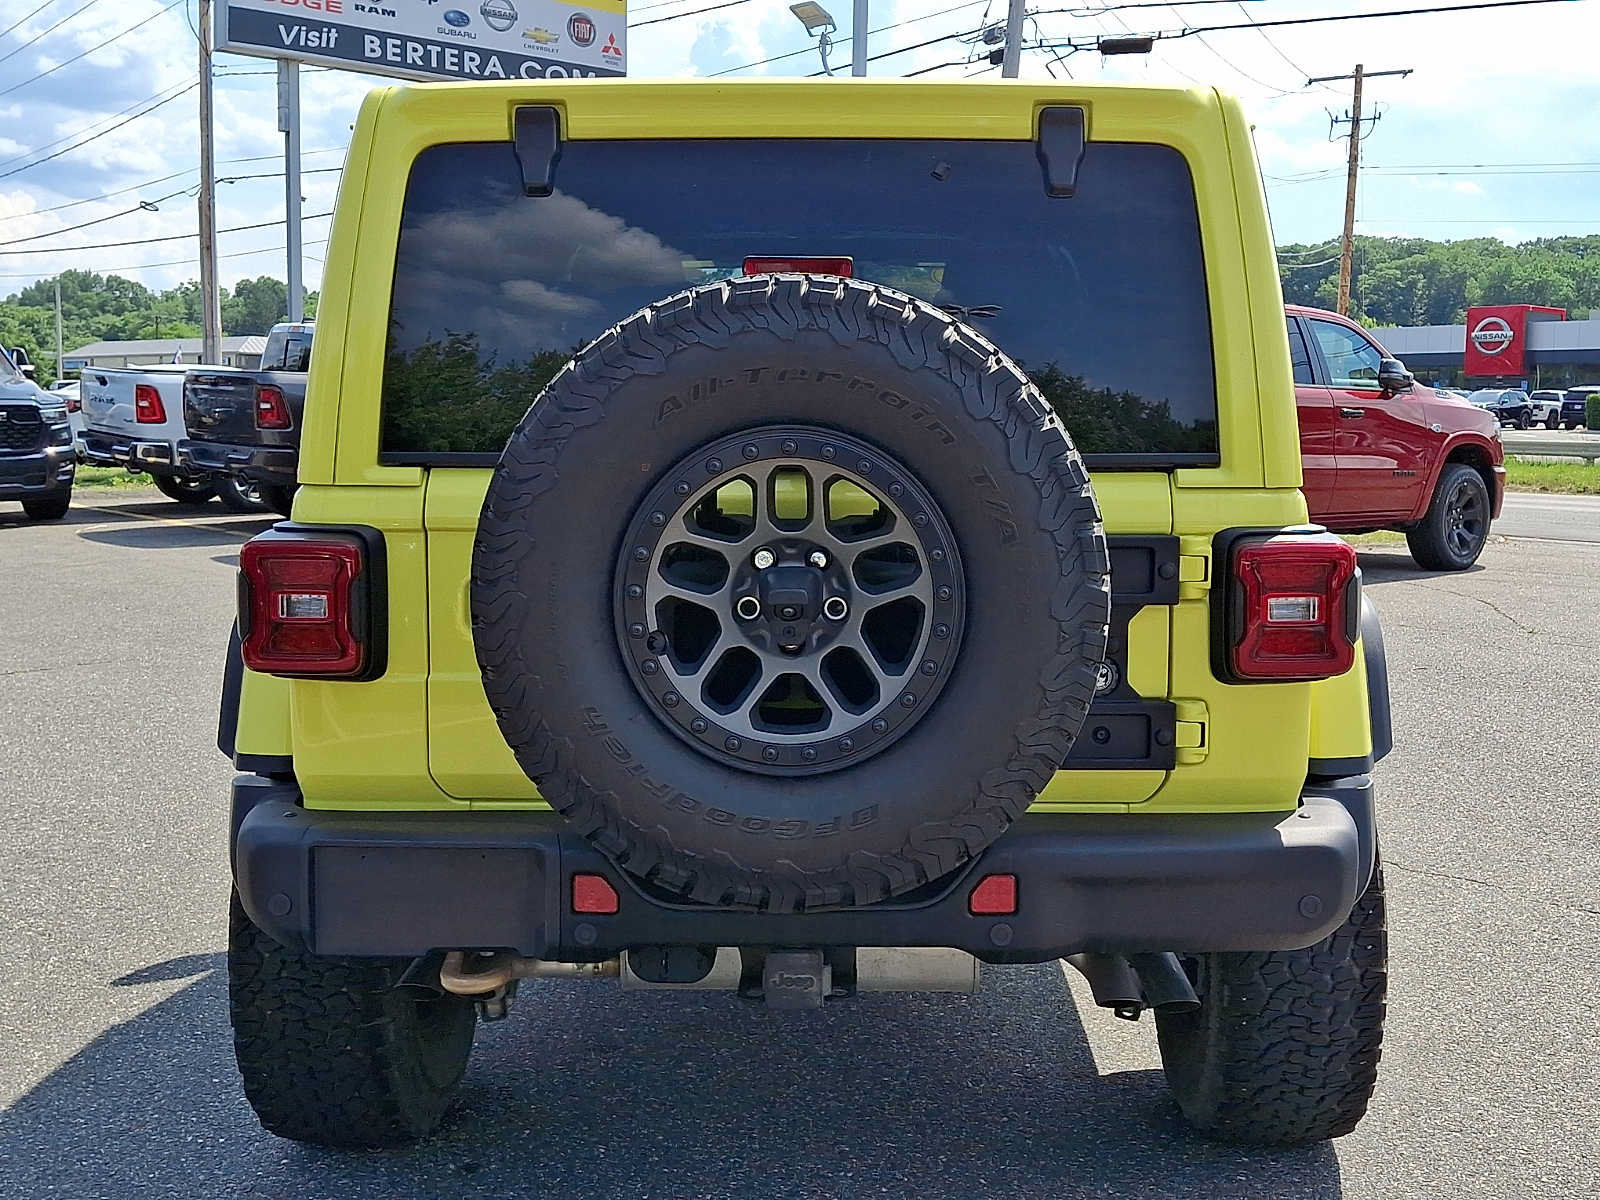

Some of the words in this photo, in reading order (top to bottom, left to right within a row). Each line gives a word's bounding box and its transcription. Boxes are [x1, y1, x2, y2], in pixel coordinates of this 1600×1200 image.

[354, 3, 396, 17] RAM
[483, 8, 514, 19] NISSAN
[278, 24, 338, 48] Visit
[437, 27, 477, 39] SUBARU
[574, 22, 592, 39] FIAT
[523, 43, 559, 54] CHEVROLET
[654, 366, 957, 447] All-Terrain
